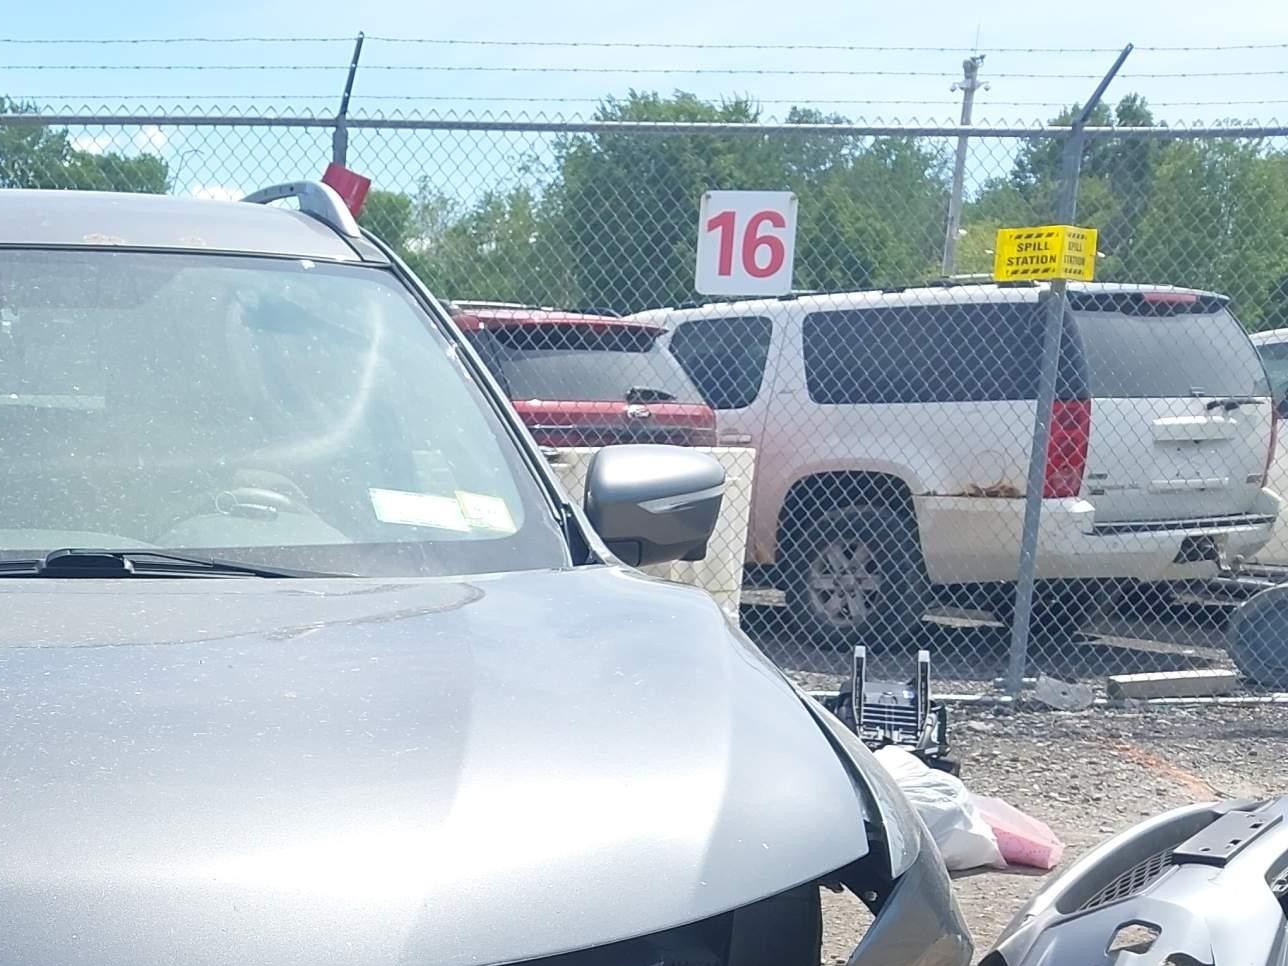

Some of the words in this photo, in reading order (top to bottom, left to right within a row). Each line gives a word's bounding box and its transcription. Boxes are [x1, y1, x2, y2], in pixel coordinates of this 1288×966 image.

[707, 210, 787, 278] 16
[1016, 241, 1050, 253] SPILL
[1006, 254, 1057, 267] STATION
